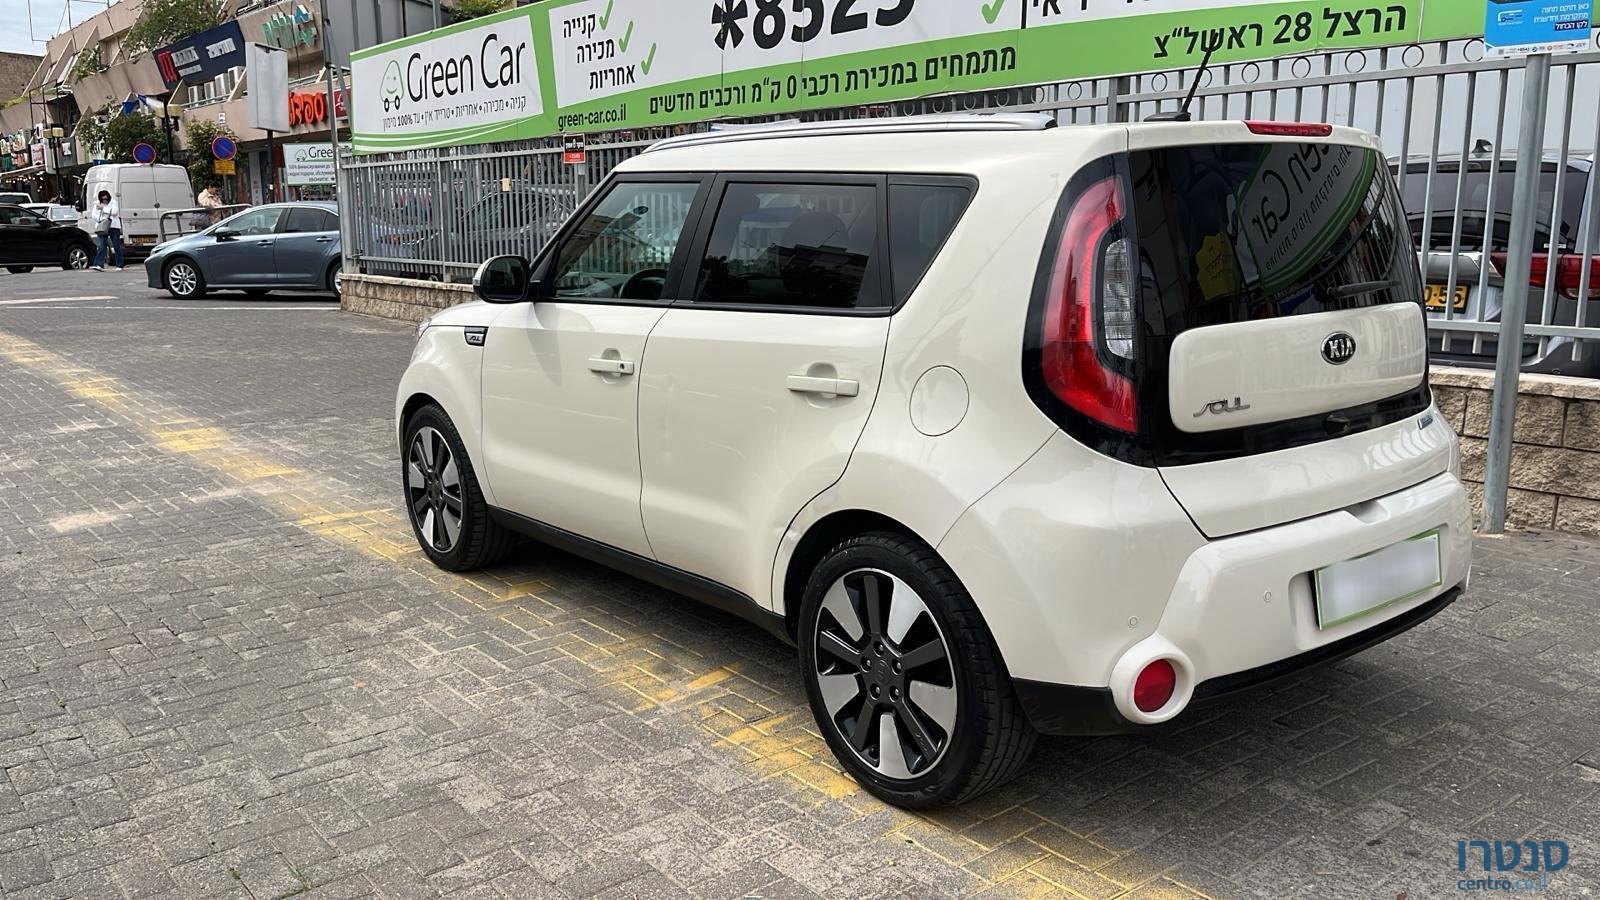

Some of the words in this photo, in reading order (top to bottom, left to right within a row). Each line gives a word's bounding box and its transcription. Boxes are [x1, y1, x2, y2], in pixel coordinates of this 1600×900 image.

[563, 13, 596, 40] קנייה
[1273, 12, 1312, 45] 28
[1323, 5, 1407, 39] הרצל
[576, 38, 615, 64] מכירה
[925, 46, 1016, 80] מתמחים
[406, 52, 474, 103] Green
[480, 33, 526, 90] Car
[589, 64, 636, 91] אחריות
[845, 60, 918, 91] במכירת
[699, 85, 747, 108] ורכבים
[786, 77, 797, 99] 0
[802, 72, 839, 97] רכבי
[557, 102, 627, 131] green-car.co.il
[650, 91, 695, 115] חדשים
[308, 146, 333, 159] Gree
[1328, 337, 1353, 359] KIA
